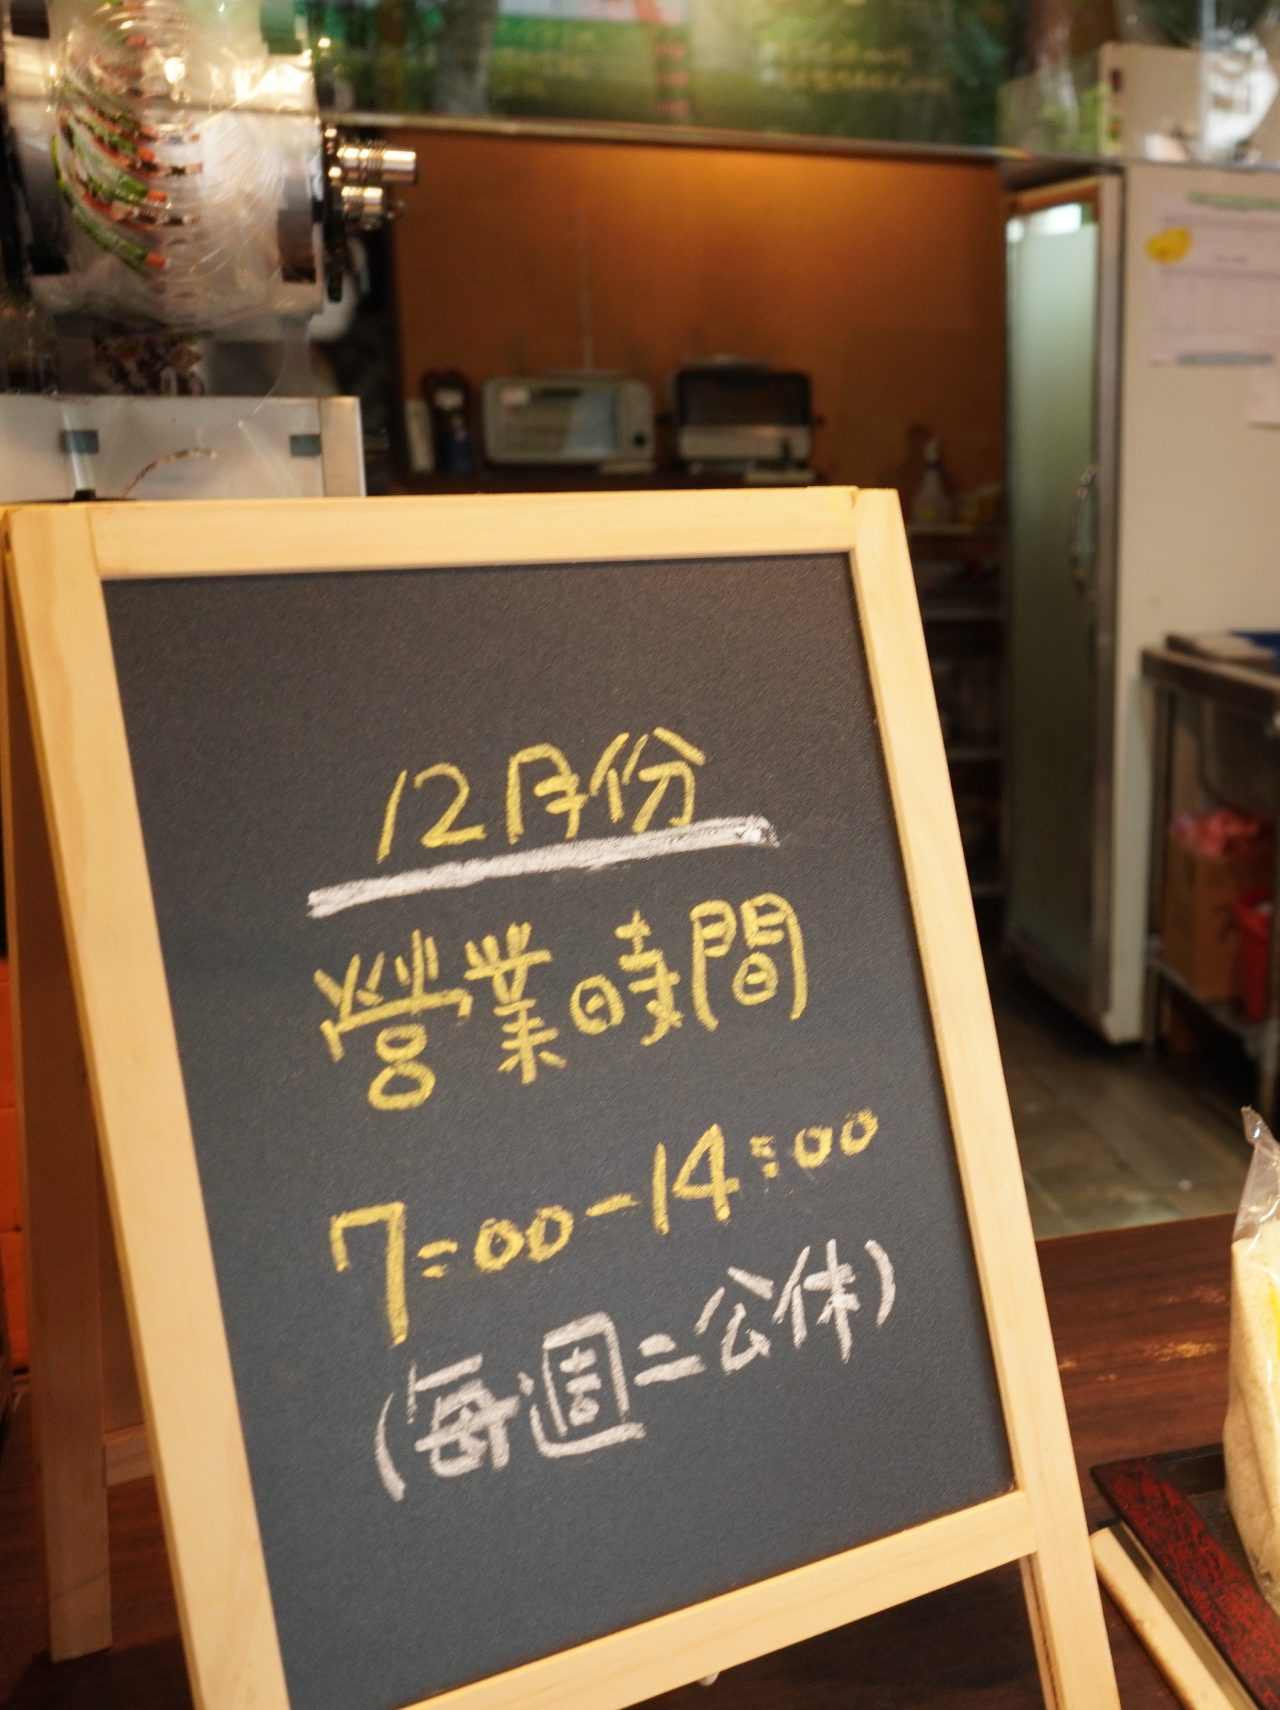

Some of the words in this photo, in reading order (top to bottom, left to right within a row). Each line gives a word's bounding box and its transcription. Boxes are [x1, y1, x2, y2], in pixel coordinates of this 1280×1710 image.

[376, 726, 706, 863] 12月份
[313, 893, 809, 1112] 營業時間
